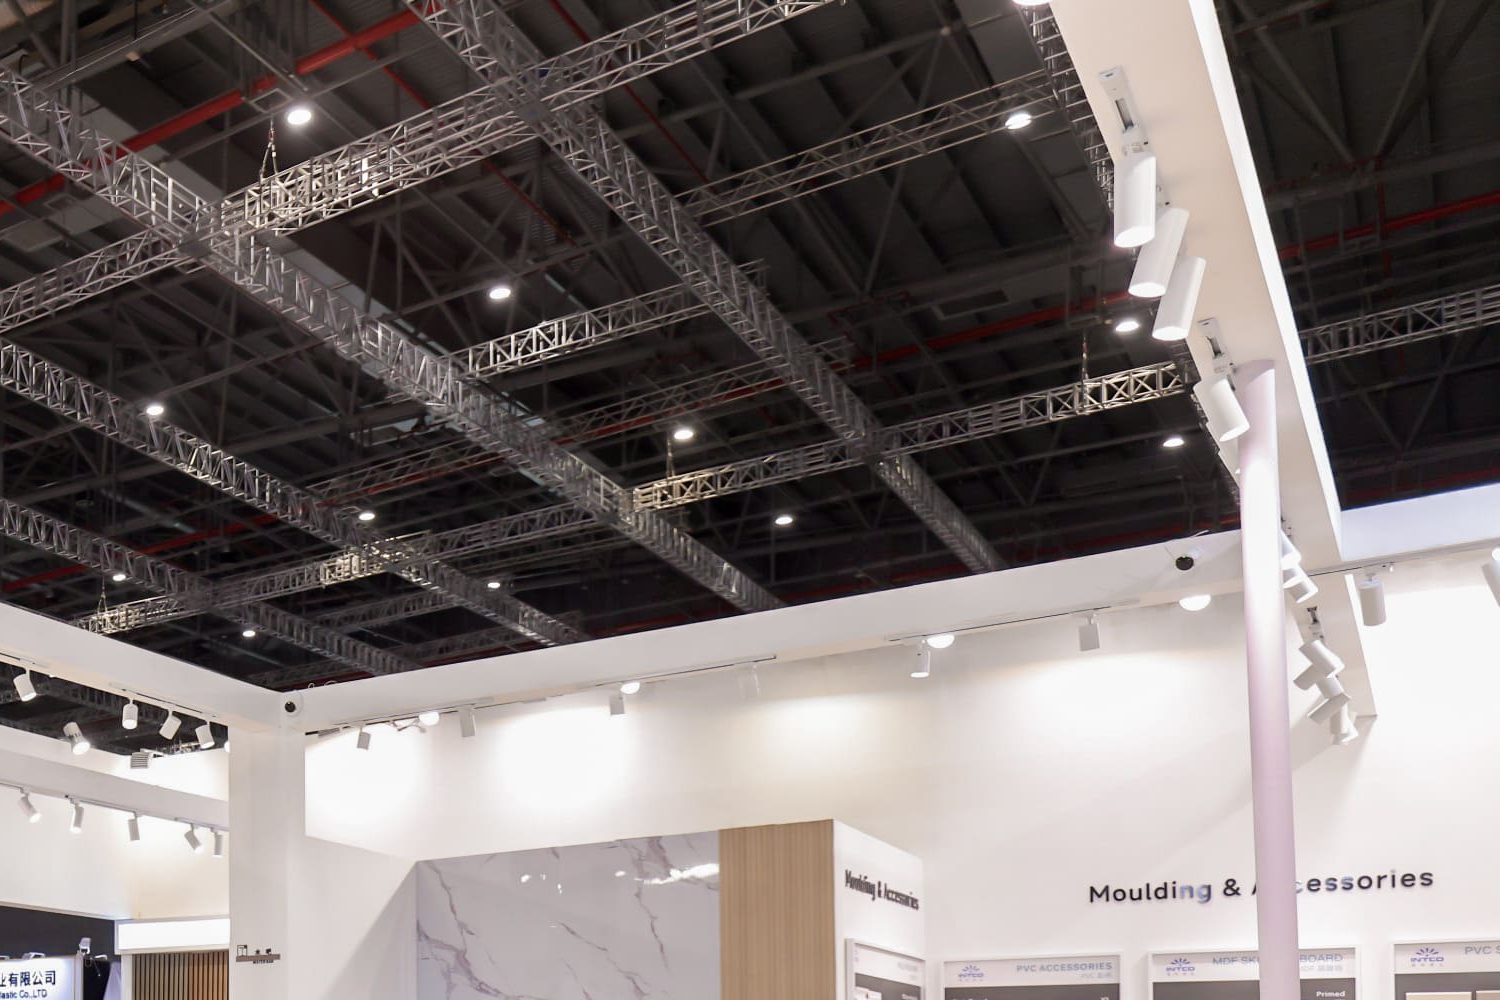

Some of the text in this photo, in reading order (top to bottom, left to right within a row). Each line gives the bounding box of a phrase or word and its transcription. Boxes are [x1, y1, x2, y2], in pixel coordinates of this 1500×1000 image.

[1088, 869, 1435, 904] Moulding & cessories
[1464, 945, 1492, 955] PVC
[1212, 956, 1238, 966] MDF
[1299, 953, 1344, 963] BOARD
[1016, 962, 1113, 973] PVC ACCESSORIES
